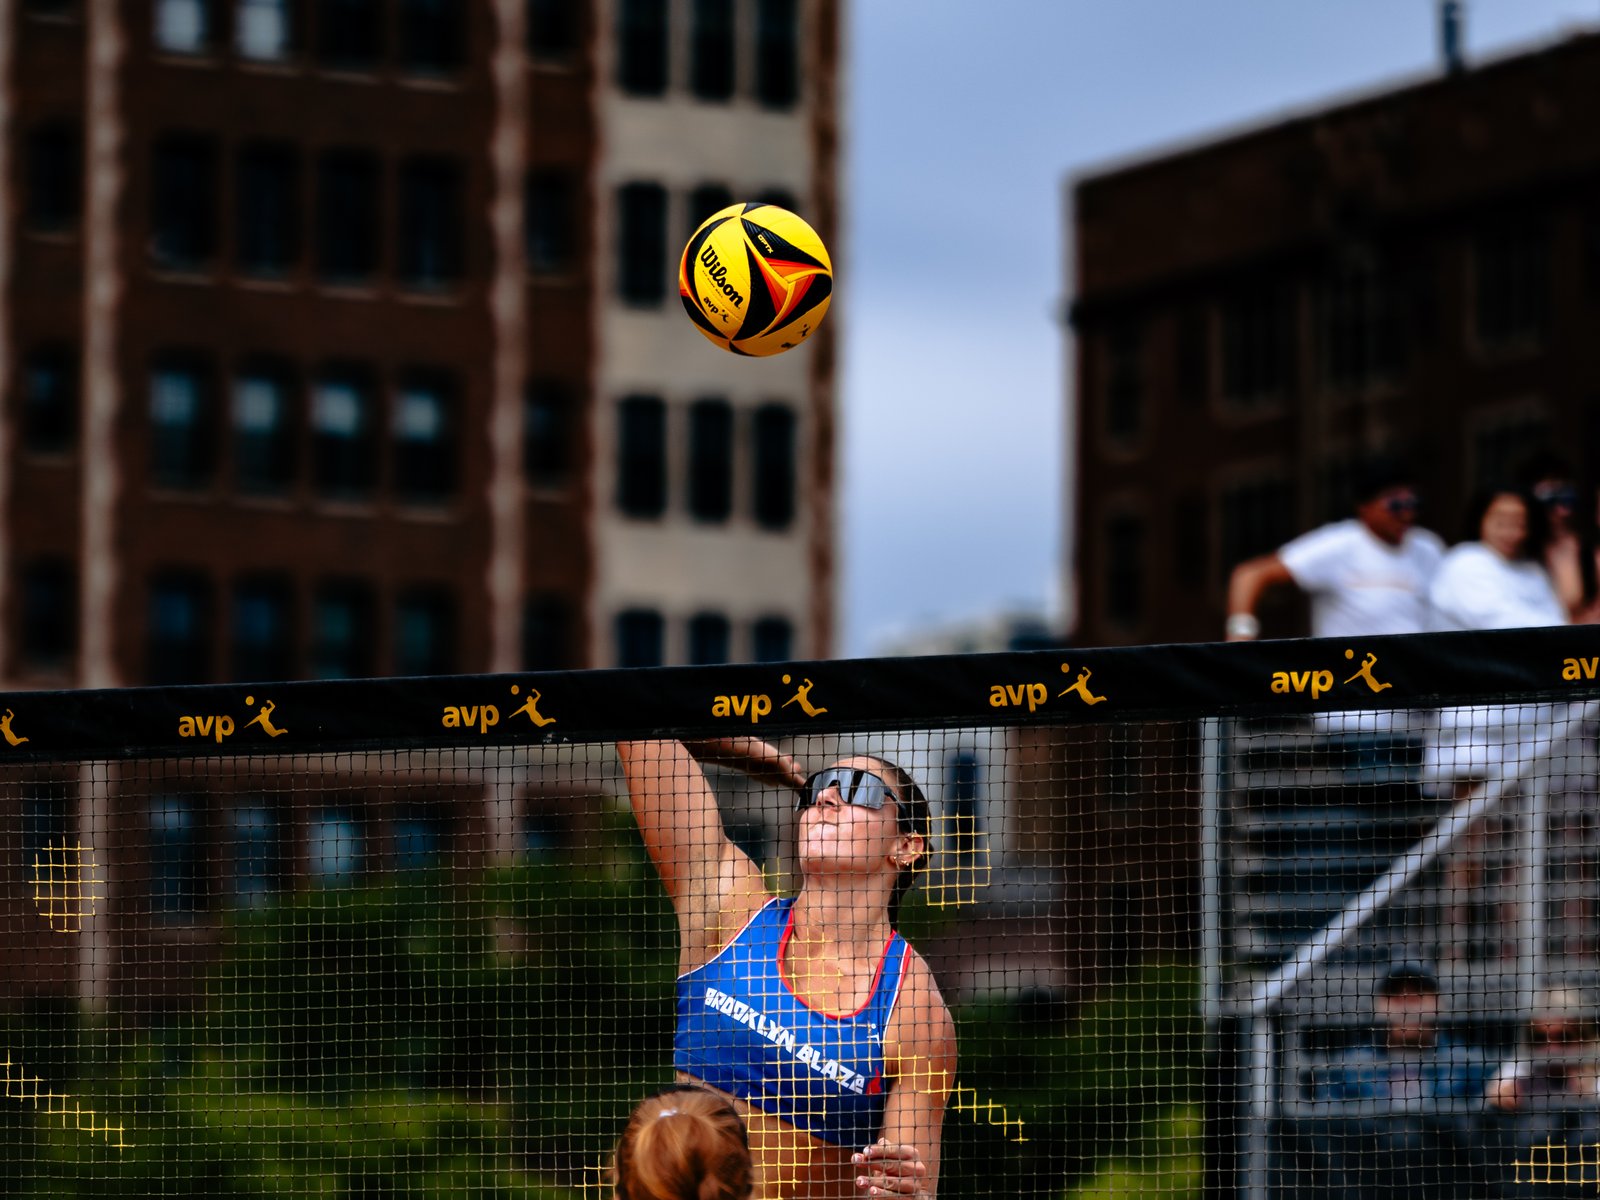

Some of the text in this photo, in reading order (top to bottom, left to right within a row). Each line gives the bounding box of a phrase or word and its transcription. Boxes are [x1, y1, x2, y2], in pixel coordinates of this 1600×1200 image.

[701, 244, 744, 308] Wilson
[703, 296, 719, 314] avp
[989, 682, 1048, 712] avp
[1270, 669, 1334, 700] avp
[441, 704, 500, 734] avp
[711, 694, 772, 724] avp
[178, 715, 235, 743] avp
[704, 987, 796, 1053] BROOKLYN
